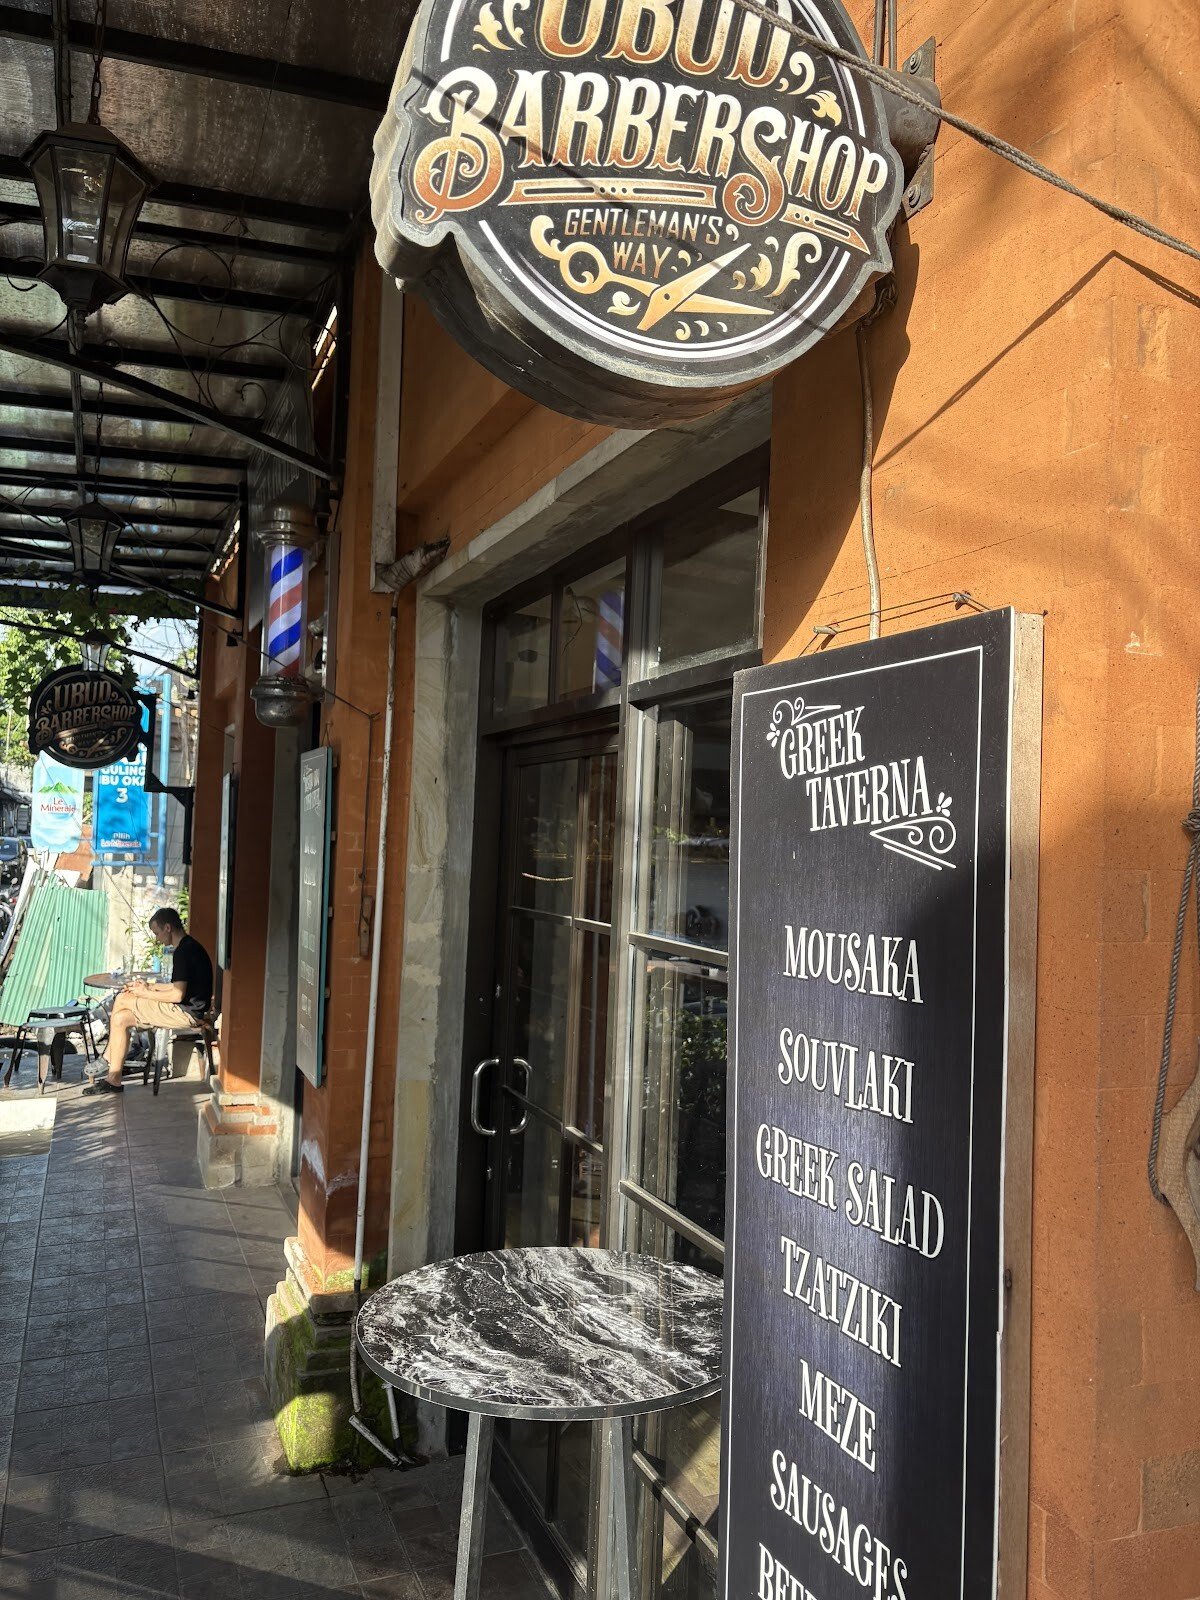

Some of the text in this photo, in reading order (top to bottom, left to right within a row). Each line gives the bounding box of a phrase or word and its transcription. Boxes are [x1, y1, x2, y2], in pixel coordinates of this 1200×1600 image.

[413, 66, 889, 226] BARBERSHOP
[564, 208, 724, 245] GENTLEMAN'S
[613, 241, 672, 279] WAY
[35, 705, 137, 748] BARBERSHOP
[54, 681, 112, 712] UBUD
[780, 706, 865, 779] GREEK
[116, 787, 128, 803] 3
[806, 756, 933, 831] TAVERNA
[783, 925, 923, 1004] MOUSAKA
[778, 1027, 915, 1123] SOUVLAKI
[756, 1123, 945, 1259] GREEK SALAD
[781, 1236, 902, 1368] TZATZIKI
[798, 1359, 876, 1472] MEZE
[770, 1449, 908, 1600] SAUSAGES
